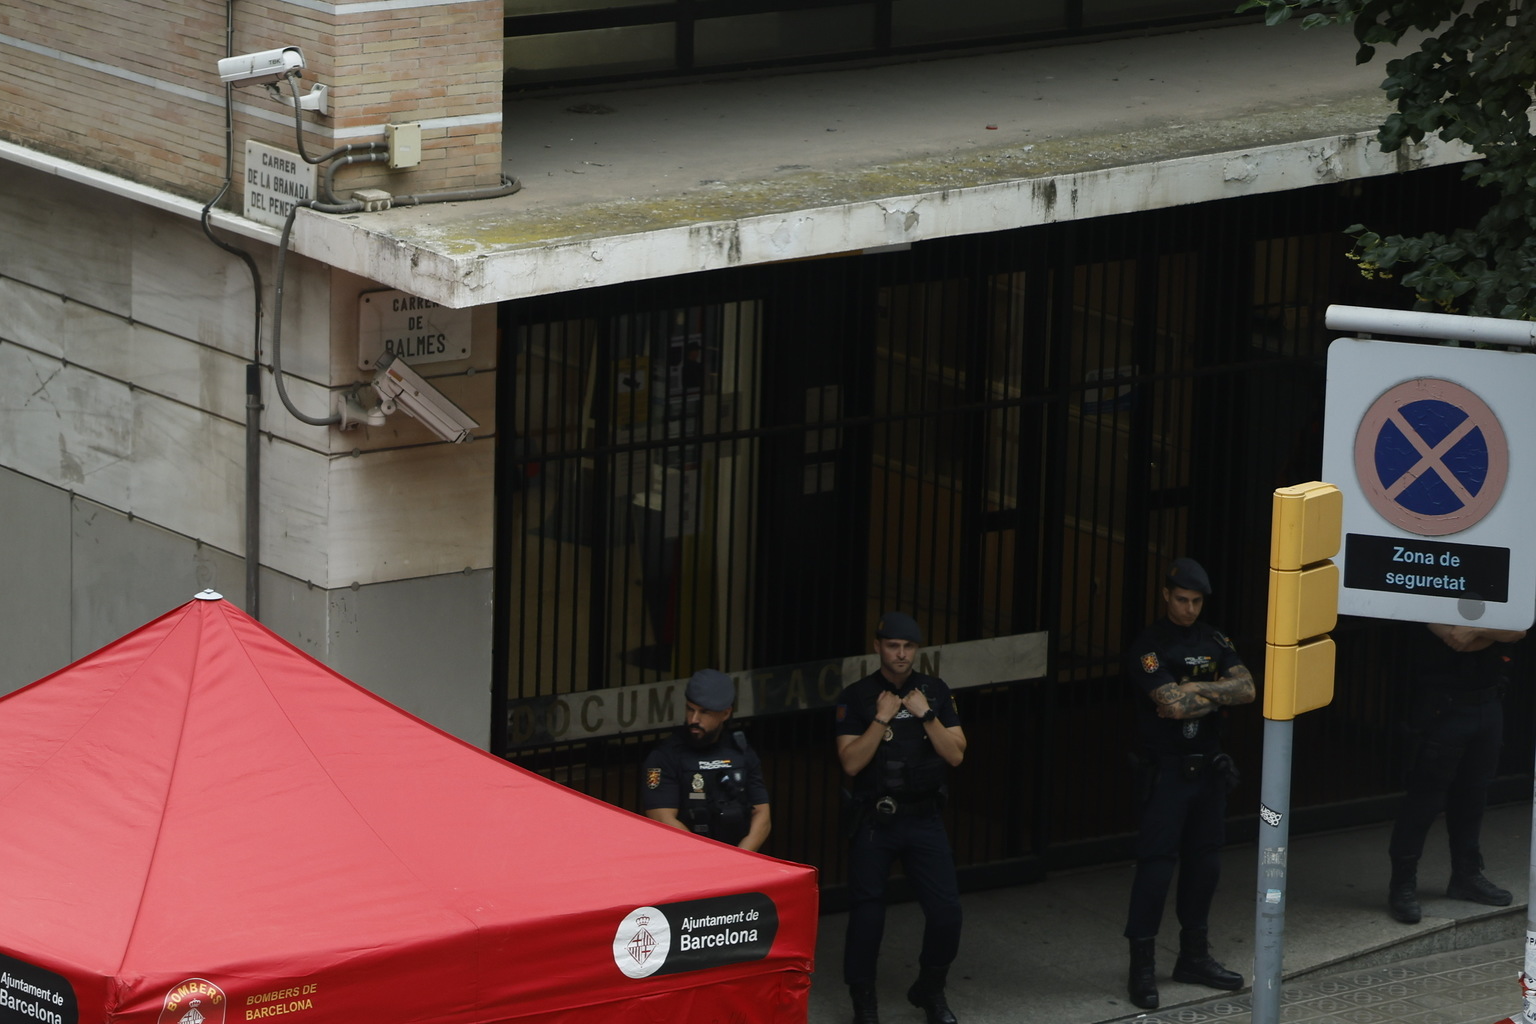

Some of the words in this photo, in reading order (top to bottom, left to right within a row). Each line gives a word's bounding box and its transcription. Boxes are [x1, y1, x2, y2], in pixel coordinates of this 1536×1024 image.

[262, 152, 296, 175] CARRER
[248, 168, 258, 186] DE
[261, 172, 270, 189] LA
[274, 176, 309, 200] GRANADA
[251, 191, 266, 211] DEL
[269, 197, 295, 218] PENE
[408, 316, 423, 331] DE
[1393, 546, 1434, 566] Zona
[1439, 551, 1461, 567] de
[1385, 569, 1466, 591] seguretat
[681, 910, 744, 932] Ajuntament
[746, 909, 759, 922] de
[680, 927, 758, 951] Barcelona
[0, 971, 52, 1002] Ajuntament
[52, 991, 64, 1006] de
[167, 982, 223, 1012] BOMBERS
[246, 986, 299, 1006] BOMBERS
[302, 983, 317, 995] DE
[245, 999, 313, 1021] BARCELONA
